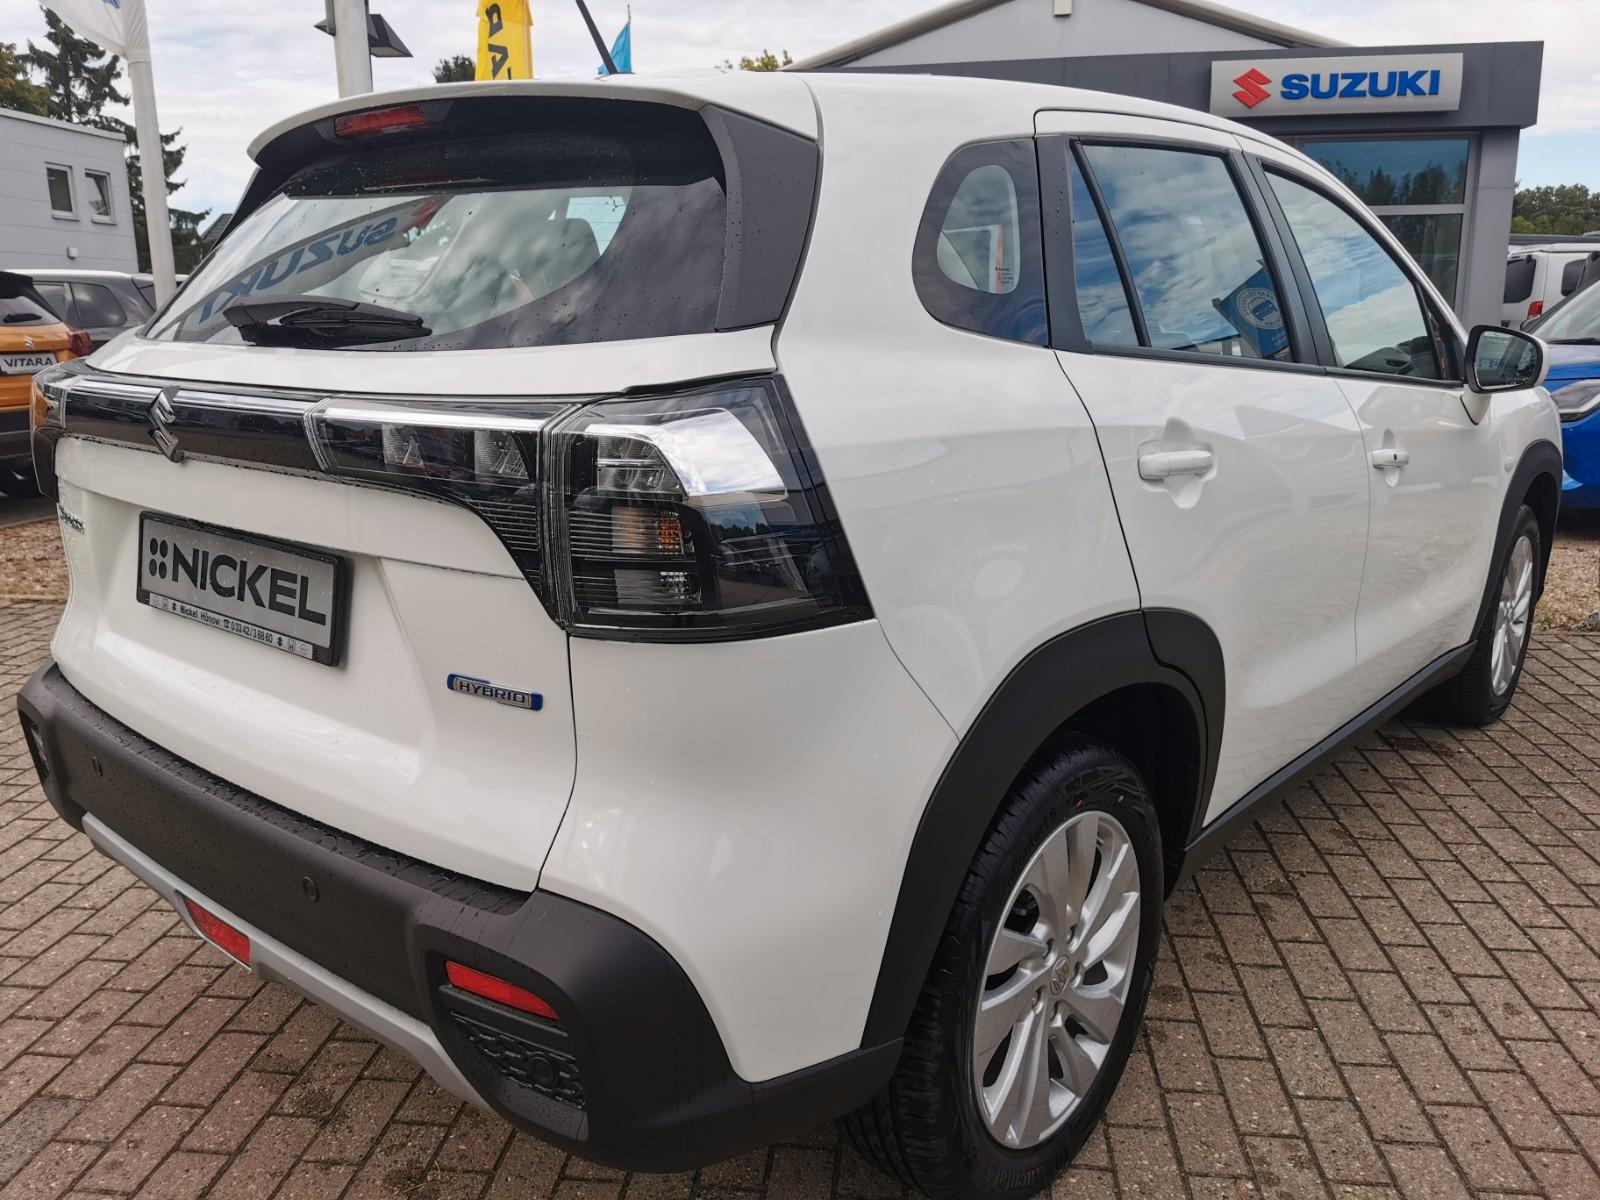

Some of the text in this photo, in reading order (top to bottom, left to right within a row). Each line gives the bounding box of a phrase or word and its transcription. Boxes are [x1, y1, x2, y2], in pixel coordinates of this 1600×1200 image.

[1280, 69, 1441, 100] SUZUKI
[3, 356, 53, 368] VITARA
[171, 543, 326, 626] NICKEL
[180, 604, 198, 618] Nickel
[459, 680, 526, 703] HYBRID
